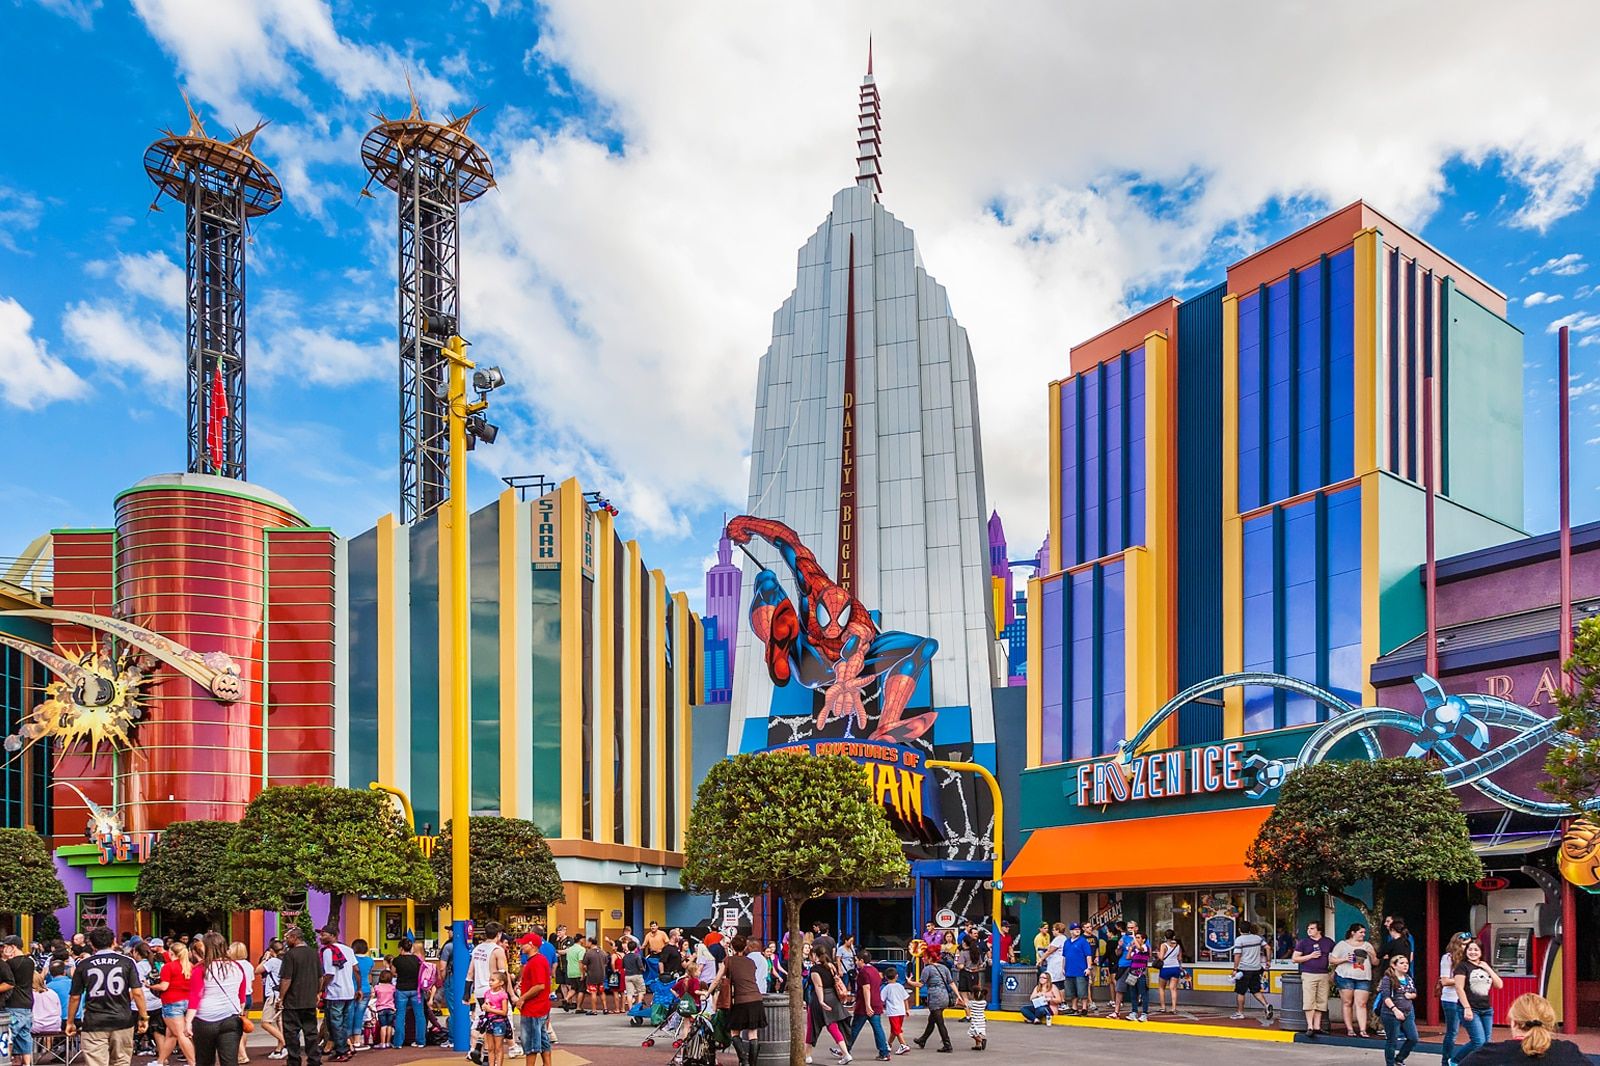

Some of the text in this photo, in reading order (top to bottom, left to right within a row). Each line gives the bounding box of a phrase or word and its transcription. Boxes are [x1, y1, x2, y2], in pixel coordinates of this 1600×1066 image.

[842, 392, 853, 485] DAILY
[816, 742, 898, 762] ADVENTURES
[903, 751, 920, 768] OF
[1077, 742, 1244, 806] FROZEN ICE
[115, 833, 131, 862] &
[1099, 902, 1121, 926] CREAM
[90, 957, 119, 966] TERRY
[87, 966, 125, 998] 26
